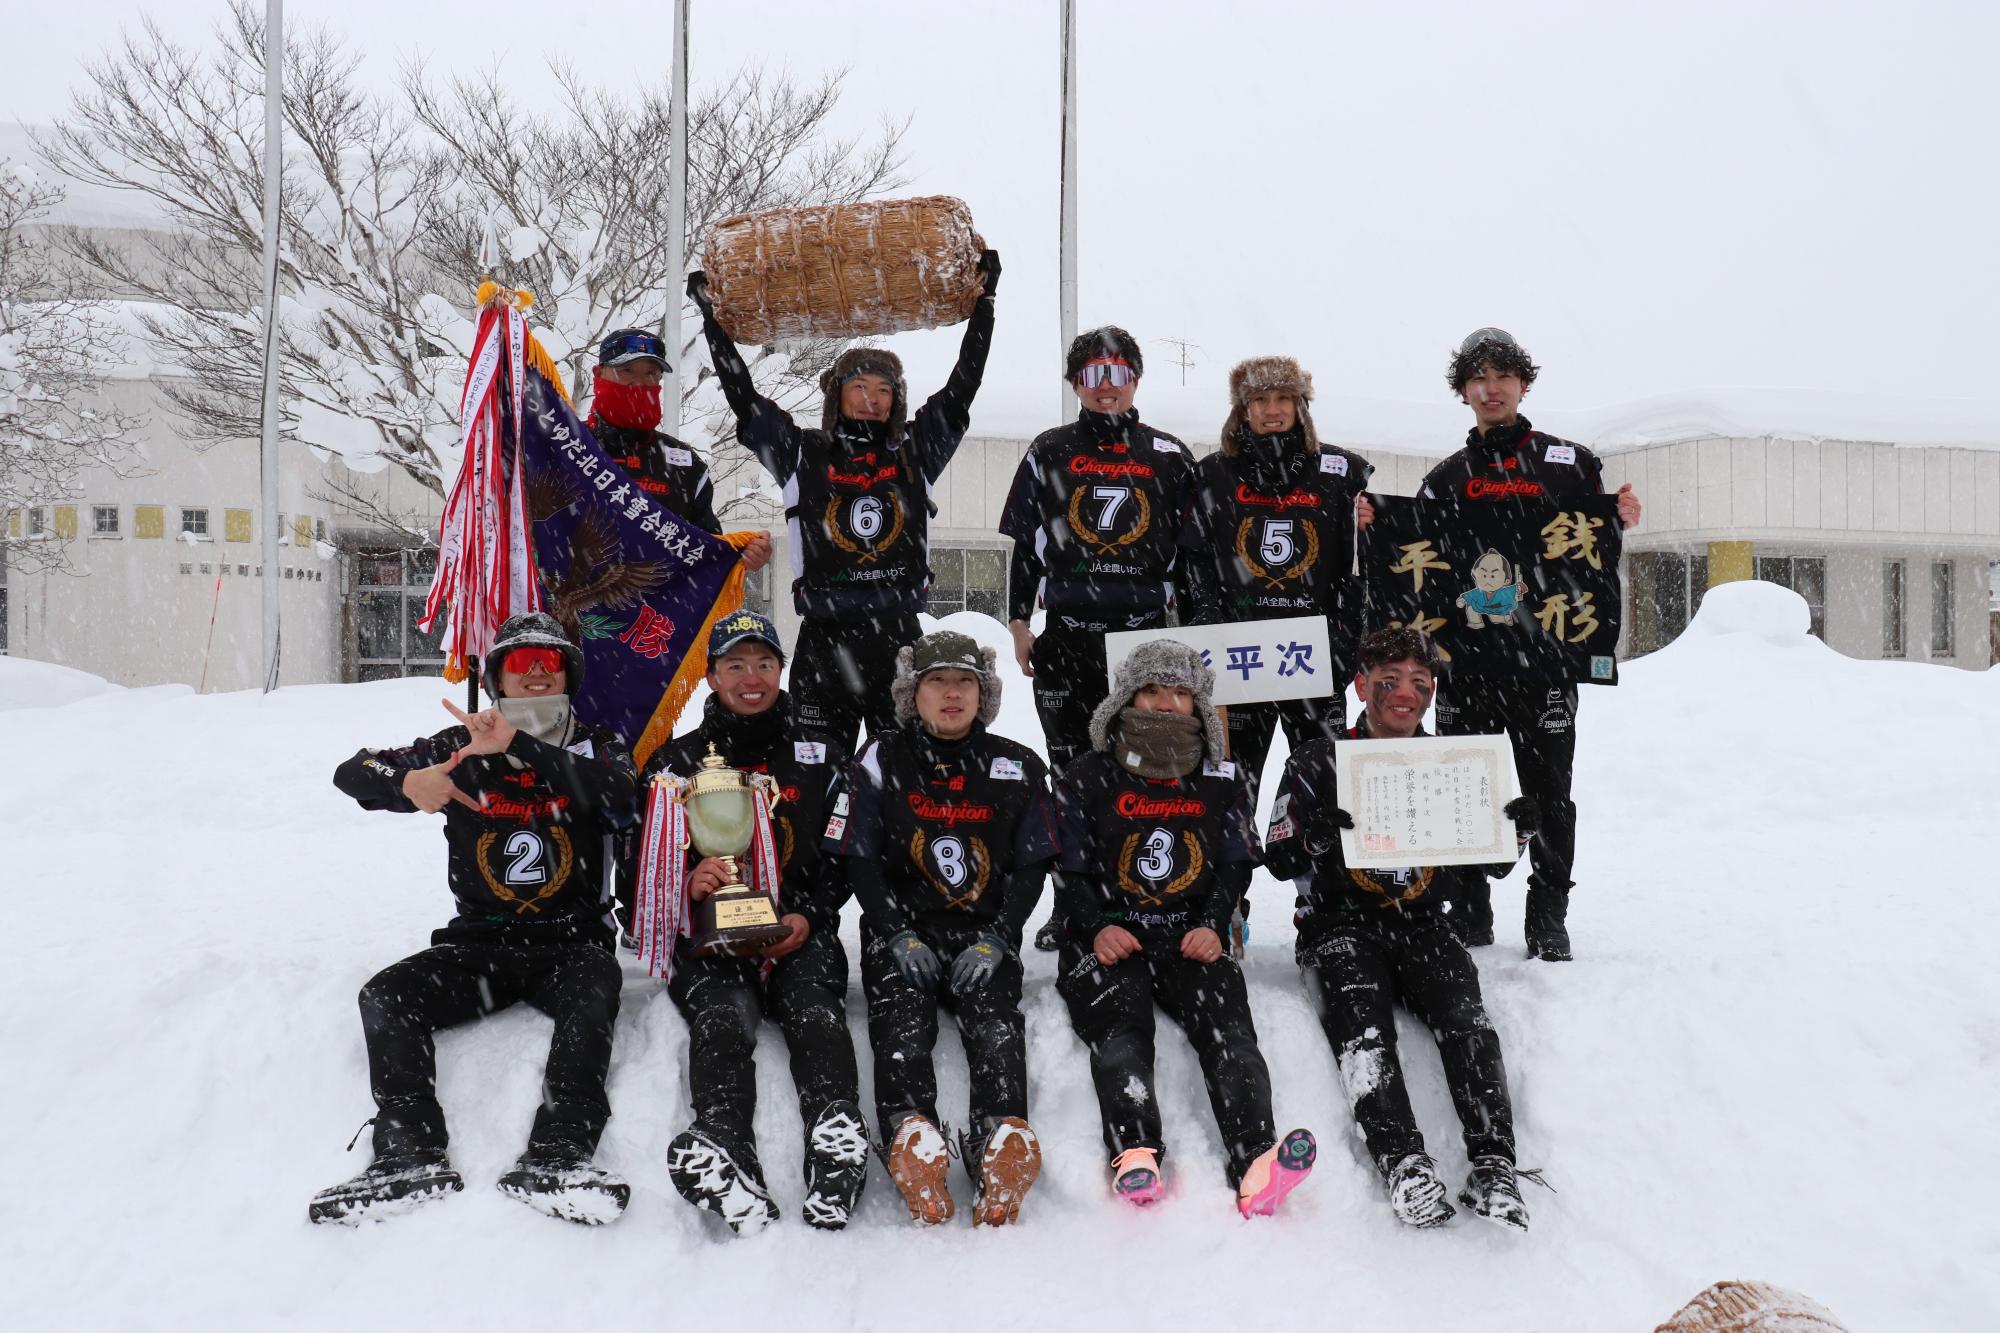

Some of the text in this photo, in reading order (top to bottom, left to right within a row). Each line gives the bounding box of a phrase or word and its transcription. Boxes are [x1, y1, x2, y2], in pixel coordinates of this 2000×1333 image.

[1068, 455, 1153, 480] Champion
[1465, 476, 1544, 501] Campion
[850, 496, 882, 539] 6
[1093, 486, 1128, 531] 7
[1260, 519, 1293, 566] 5
[1089, 562, 1144, 576] JA全農いわて
[1535, 511, 1604, 643] 銭形
[620, 604, 675, 659] 勝
[908, 792, 993, 827] Champion
[1116, 791, 1206, 820] Champion
[504, 831, 546, 885] 2
[931, 836, 967, 888] 8
[1137, 828, 1174, 881] 3
